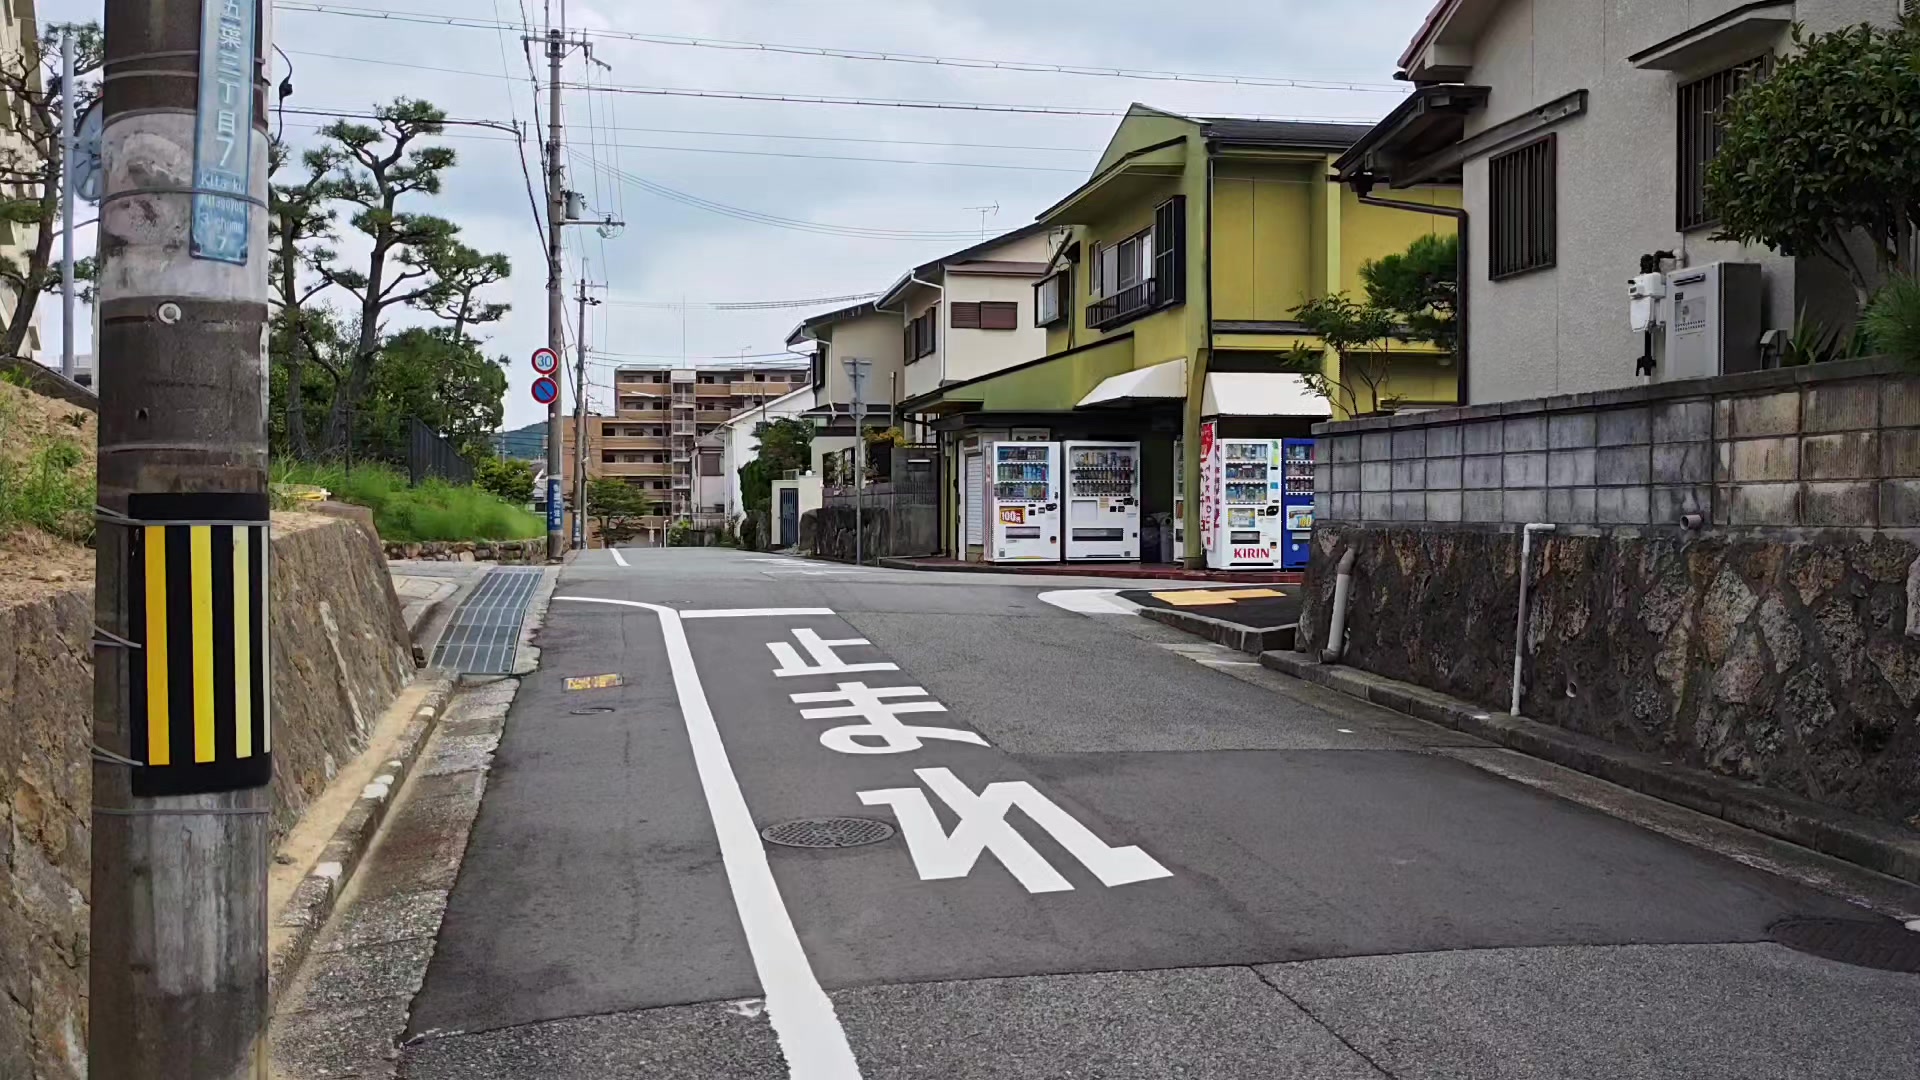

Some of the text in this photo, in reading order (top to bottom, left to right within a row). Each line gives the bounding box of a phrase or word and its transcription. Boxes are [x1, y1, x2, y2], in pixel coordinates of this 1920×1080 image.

[217, 236, 227, 250] 7
[537, 355, 552, 368] 30
[1233, 548, 1270, 558] KIRIN
[766, 628, 1174, 893] 止まれ
